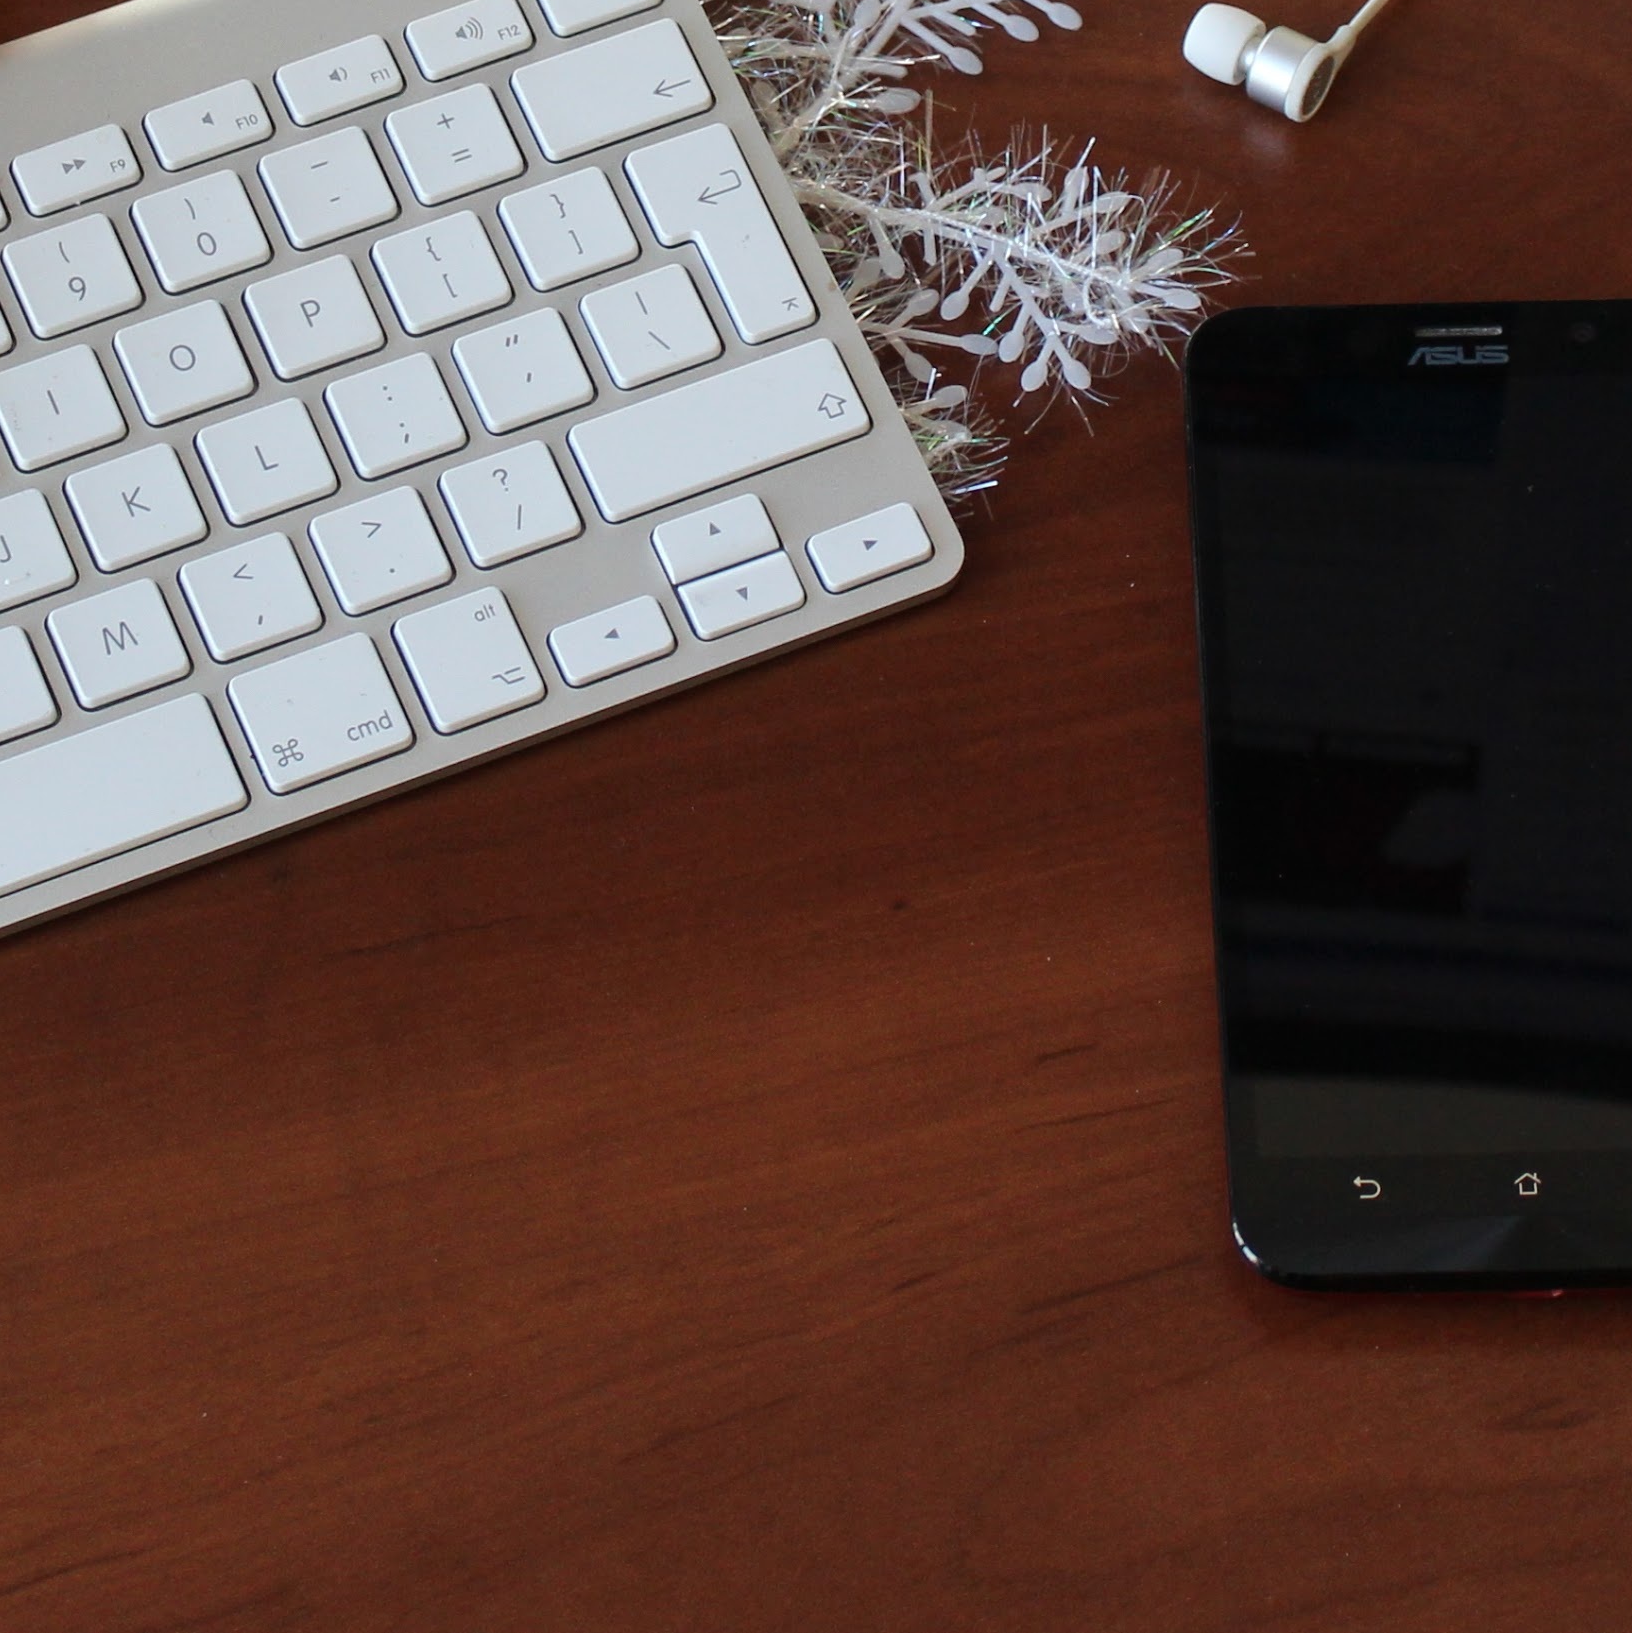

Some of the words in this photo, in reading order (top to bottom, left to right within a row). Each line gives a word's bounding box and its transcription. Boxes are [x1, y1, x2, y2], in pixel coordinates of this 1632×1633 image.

[498, 25, 520, 40] F12
[371, 69, 390, 83] F11
[235, 114, 258, 129] F10
[110, 159, 125, 172] F9
[69, 277, 86, 300] 9
[300, 300, 320, 327] P
[169, 345, 195, 371] O
[1409, 346, 1509, 365] ASUS
[122, 487, 150, 517] K
[475, 605, 495, 621] alt
[103, 622, 138, 655] M
[347, 710, 393, 741] cmd
